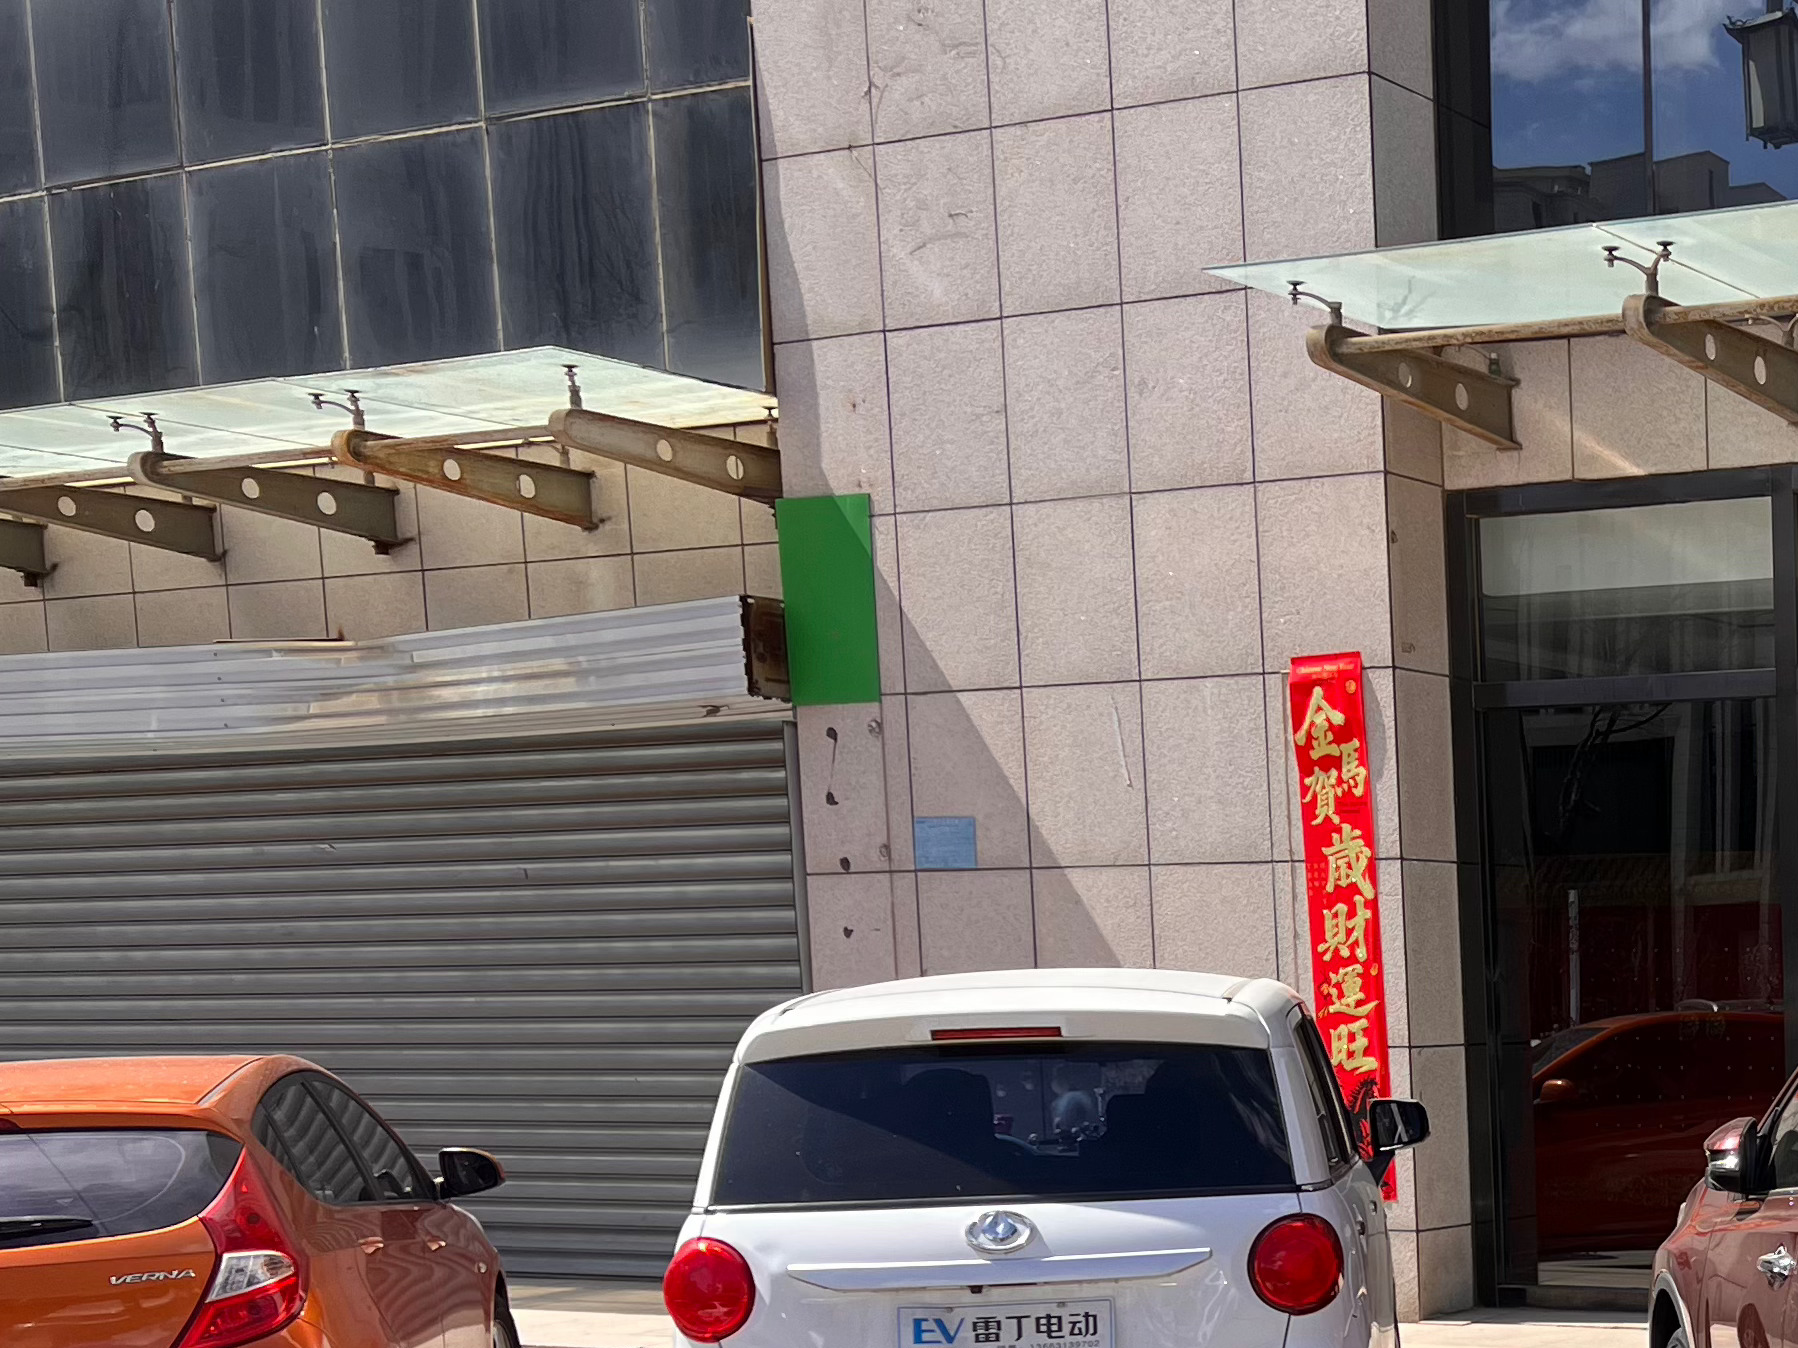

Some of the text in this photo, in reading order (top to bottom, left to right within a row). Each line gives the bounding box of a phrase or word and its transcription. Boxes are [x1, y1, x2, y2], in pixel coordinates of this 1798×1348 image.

[110, 1269, 196, 1285] VERNA
[913, 1311, 1098, 1345] EV 雷丁电动
